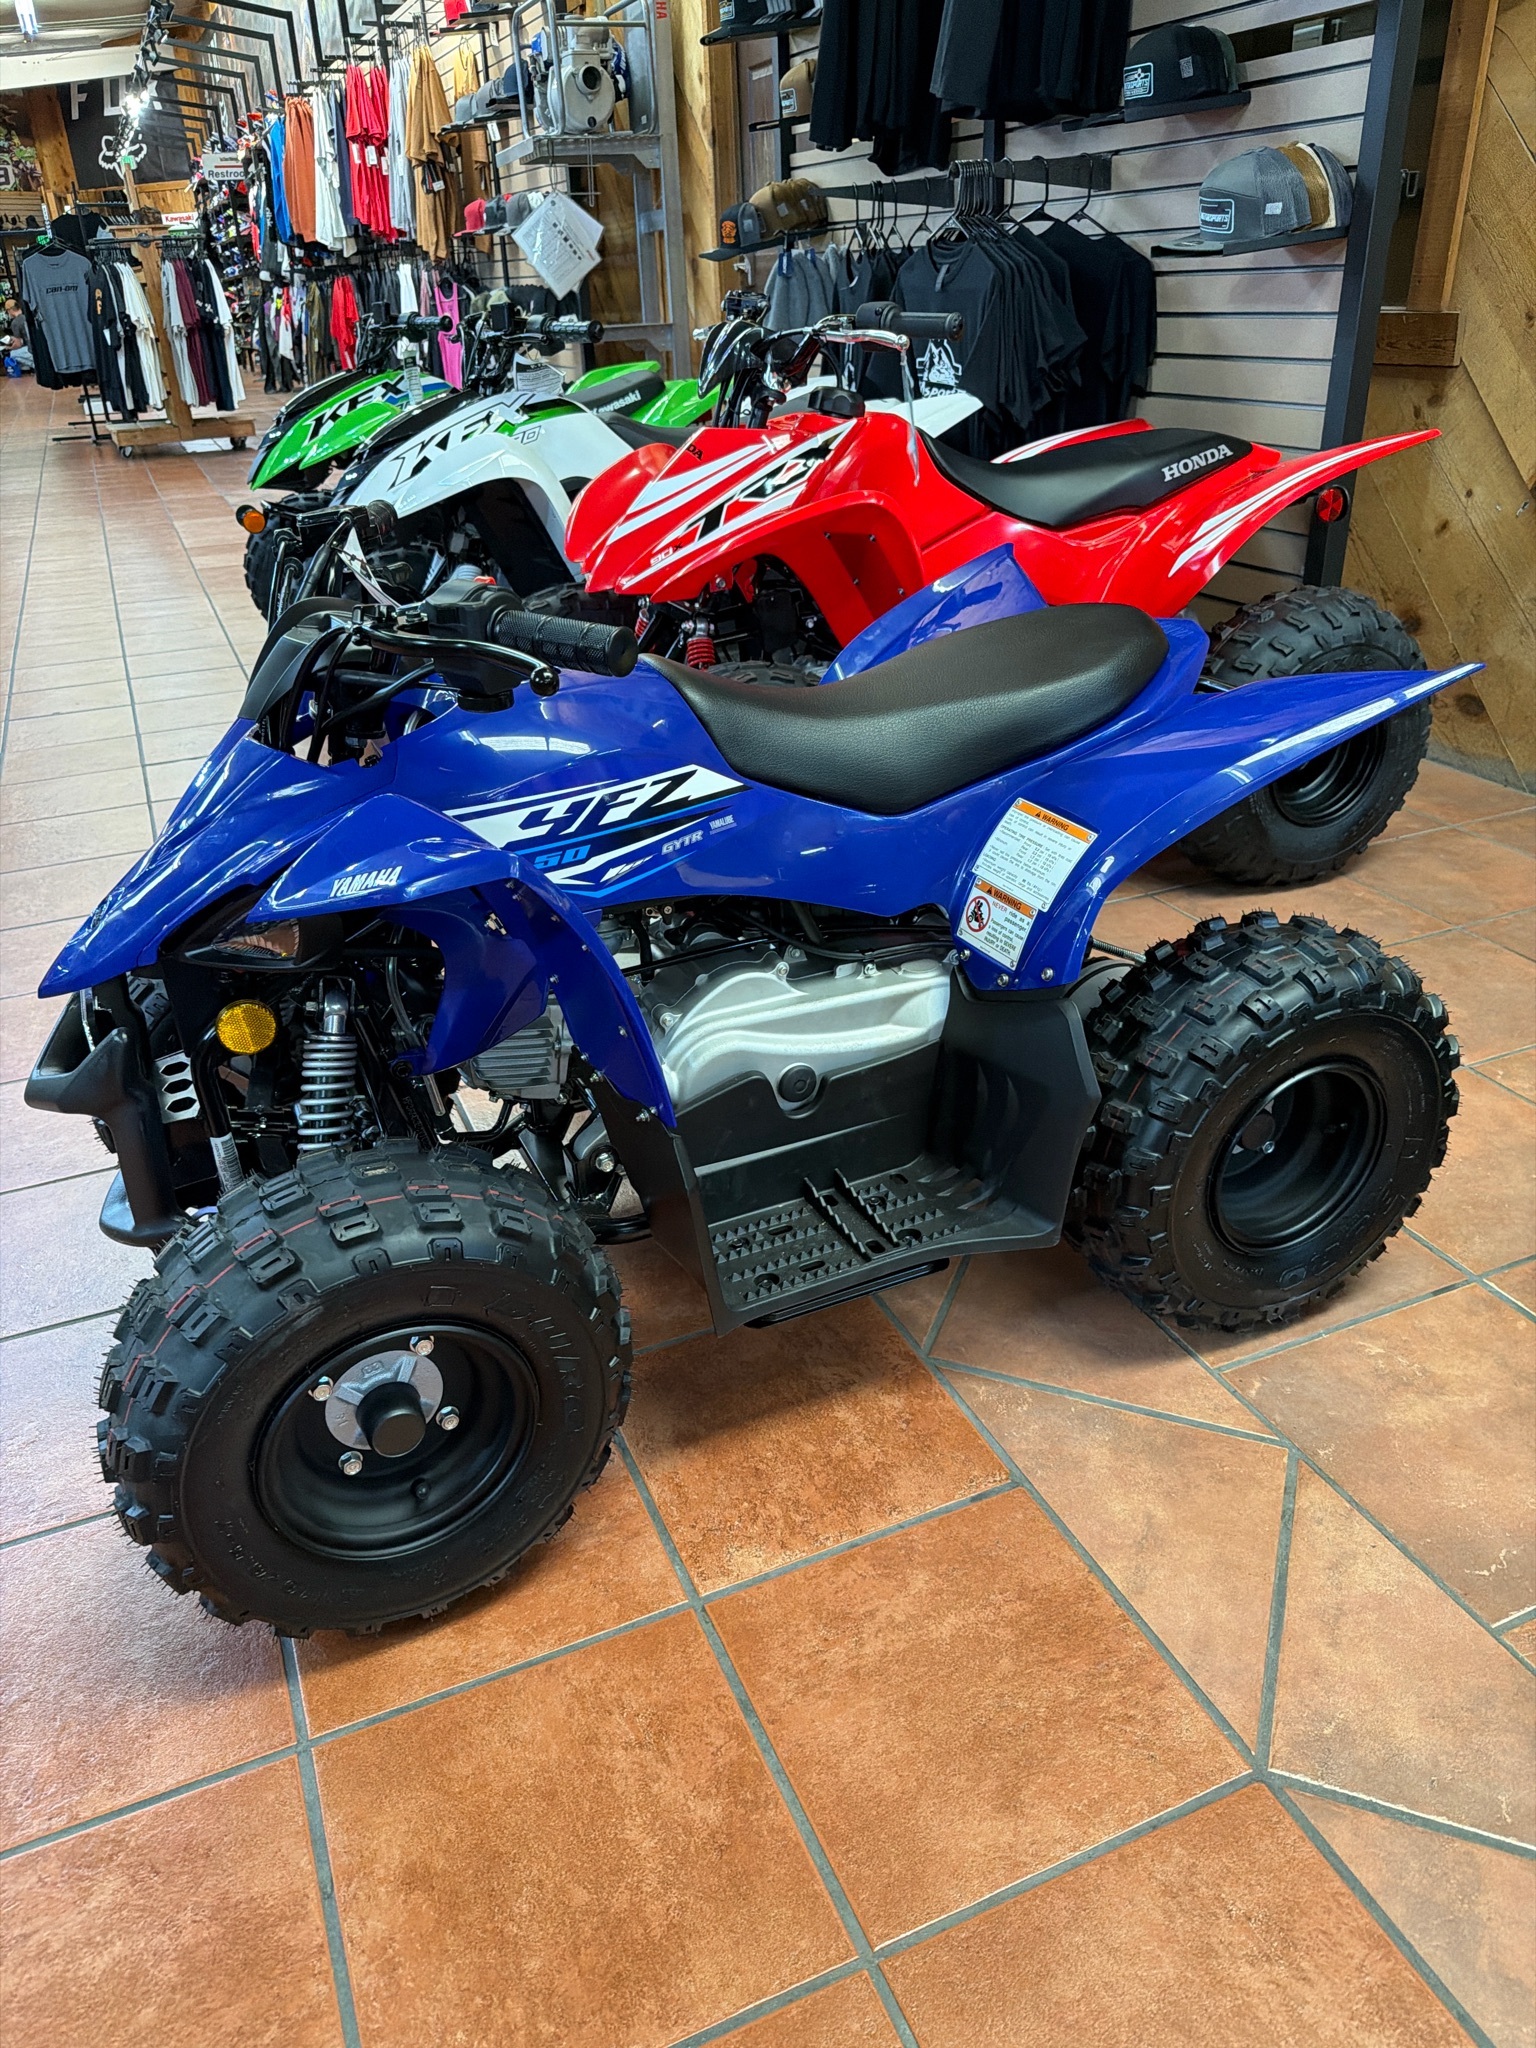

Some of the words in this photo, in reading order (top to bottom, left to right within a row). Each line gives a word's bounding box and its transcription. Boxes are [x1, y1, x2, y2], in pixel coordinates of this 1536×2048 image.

[165, 214, 194, 222] Kawasaki
[1161, 444, 1234, 482] HONDA
[518, 769, 700, 836] YFZ
[1040, 813, 1069, 831] WARNING
[661, 830, 704, 855] GYTR
[534, 845, 591, 869] 50
[330, 866, 403, 898] YAMAHA
[991, 900, 1007, 913] NEVER
[1008, 910, 1018, 919] ride
[992, 889, 1022, 910] WARNING
